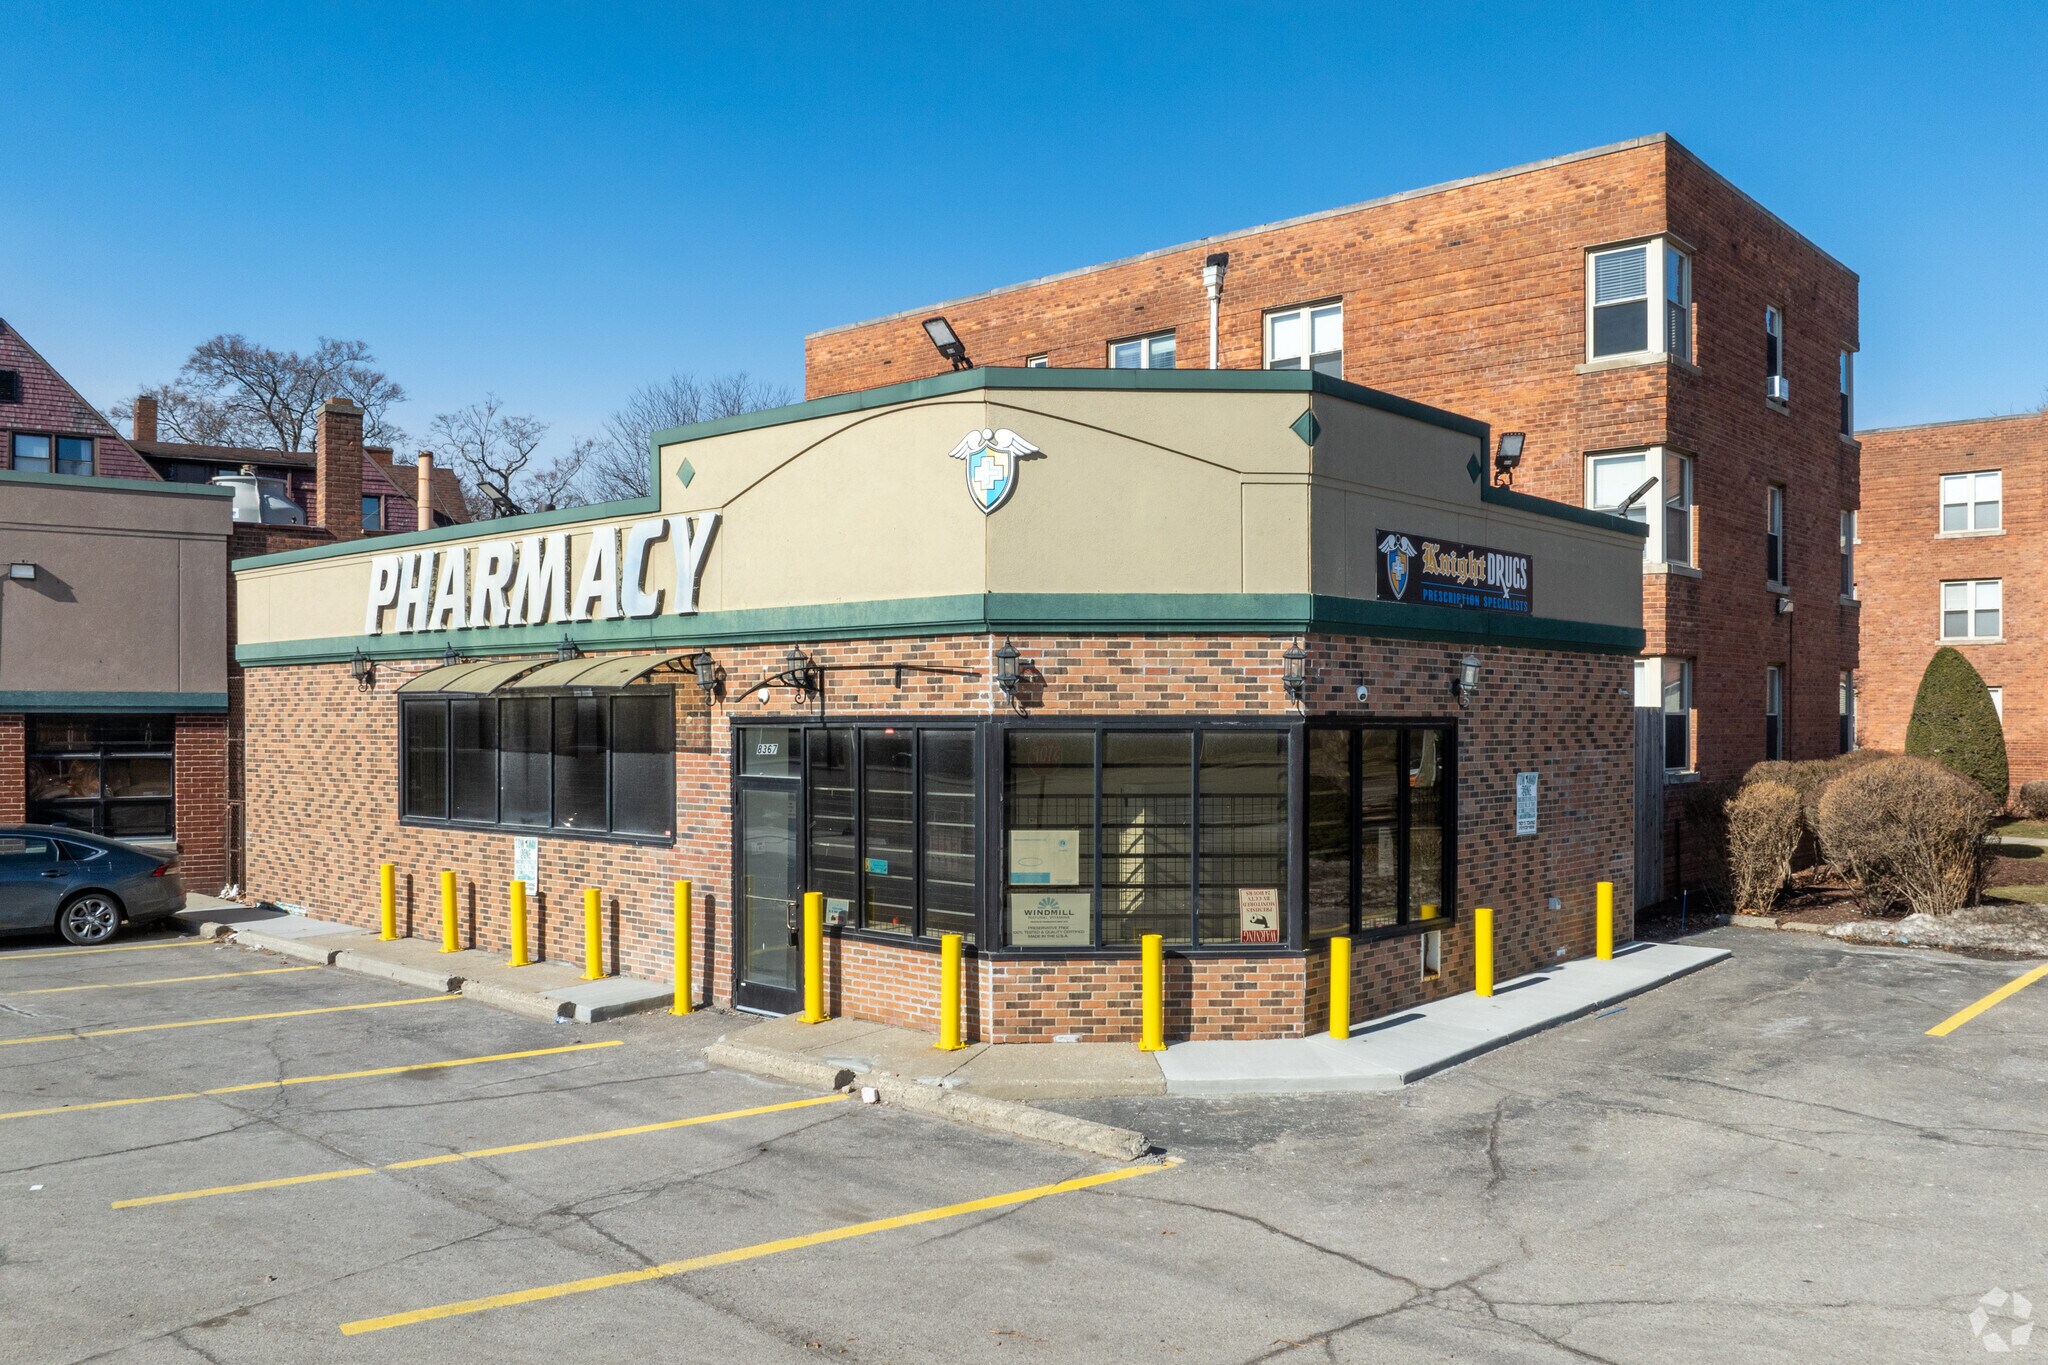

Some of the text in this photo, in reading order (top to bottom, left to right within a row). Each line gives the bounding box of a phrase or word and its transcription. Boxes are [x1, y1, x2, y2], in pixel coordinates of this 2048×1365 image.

[364, 512, 721, 635] PHARMACY
[1422, 541, 1528, 599] Knight DRUGS
[1423, 588, 1529, 613] PRESCRIPTION SPECIALISTS
[757, 744, 778, 754] 8367
[1243, 930, 1277, 942] WARNING
